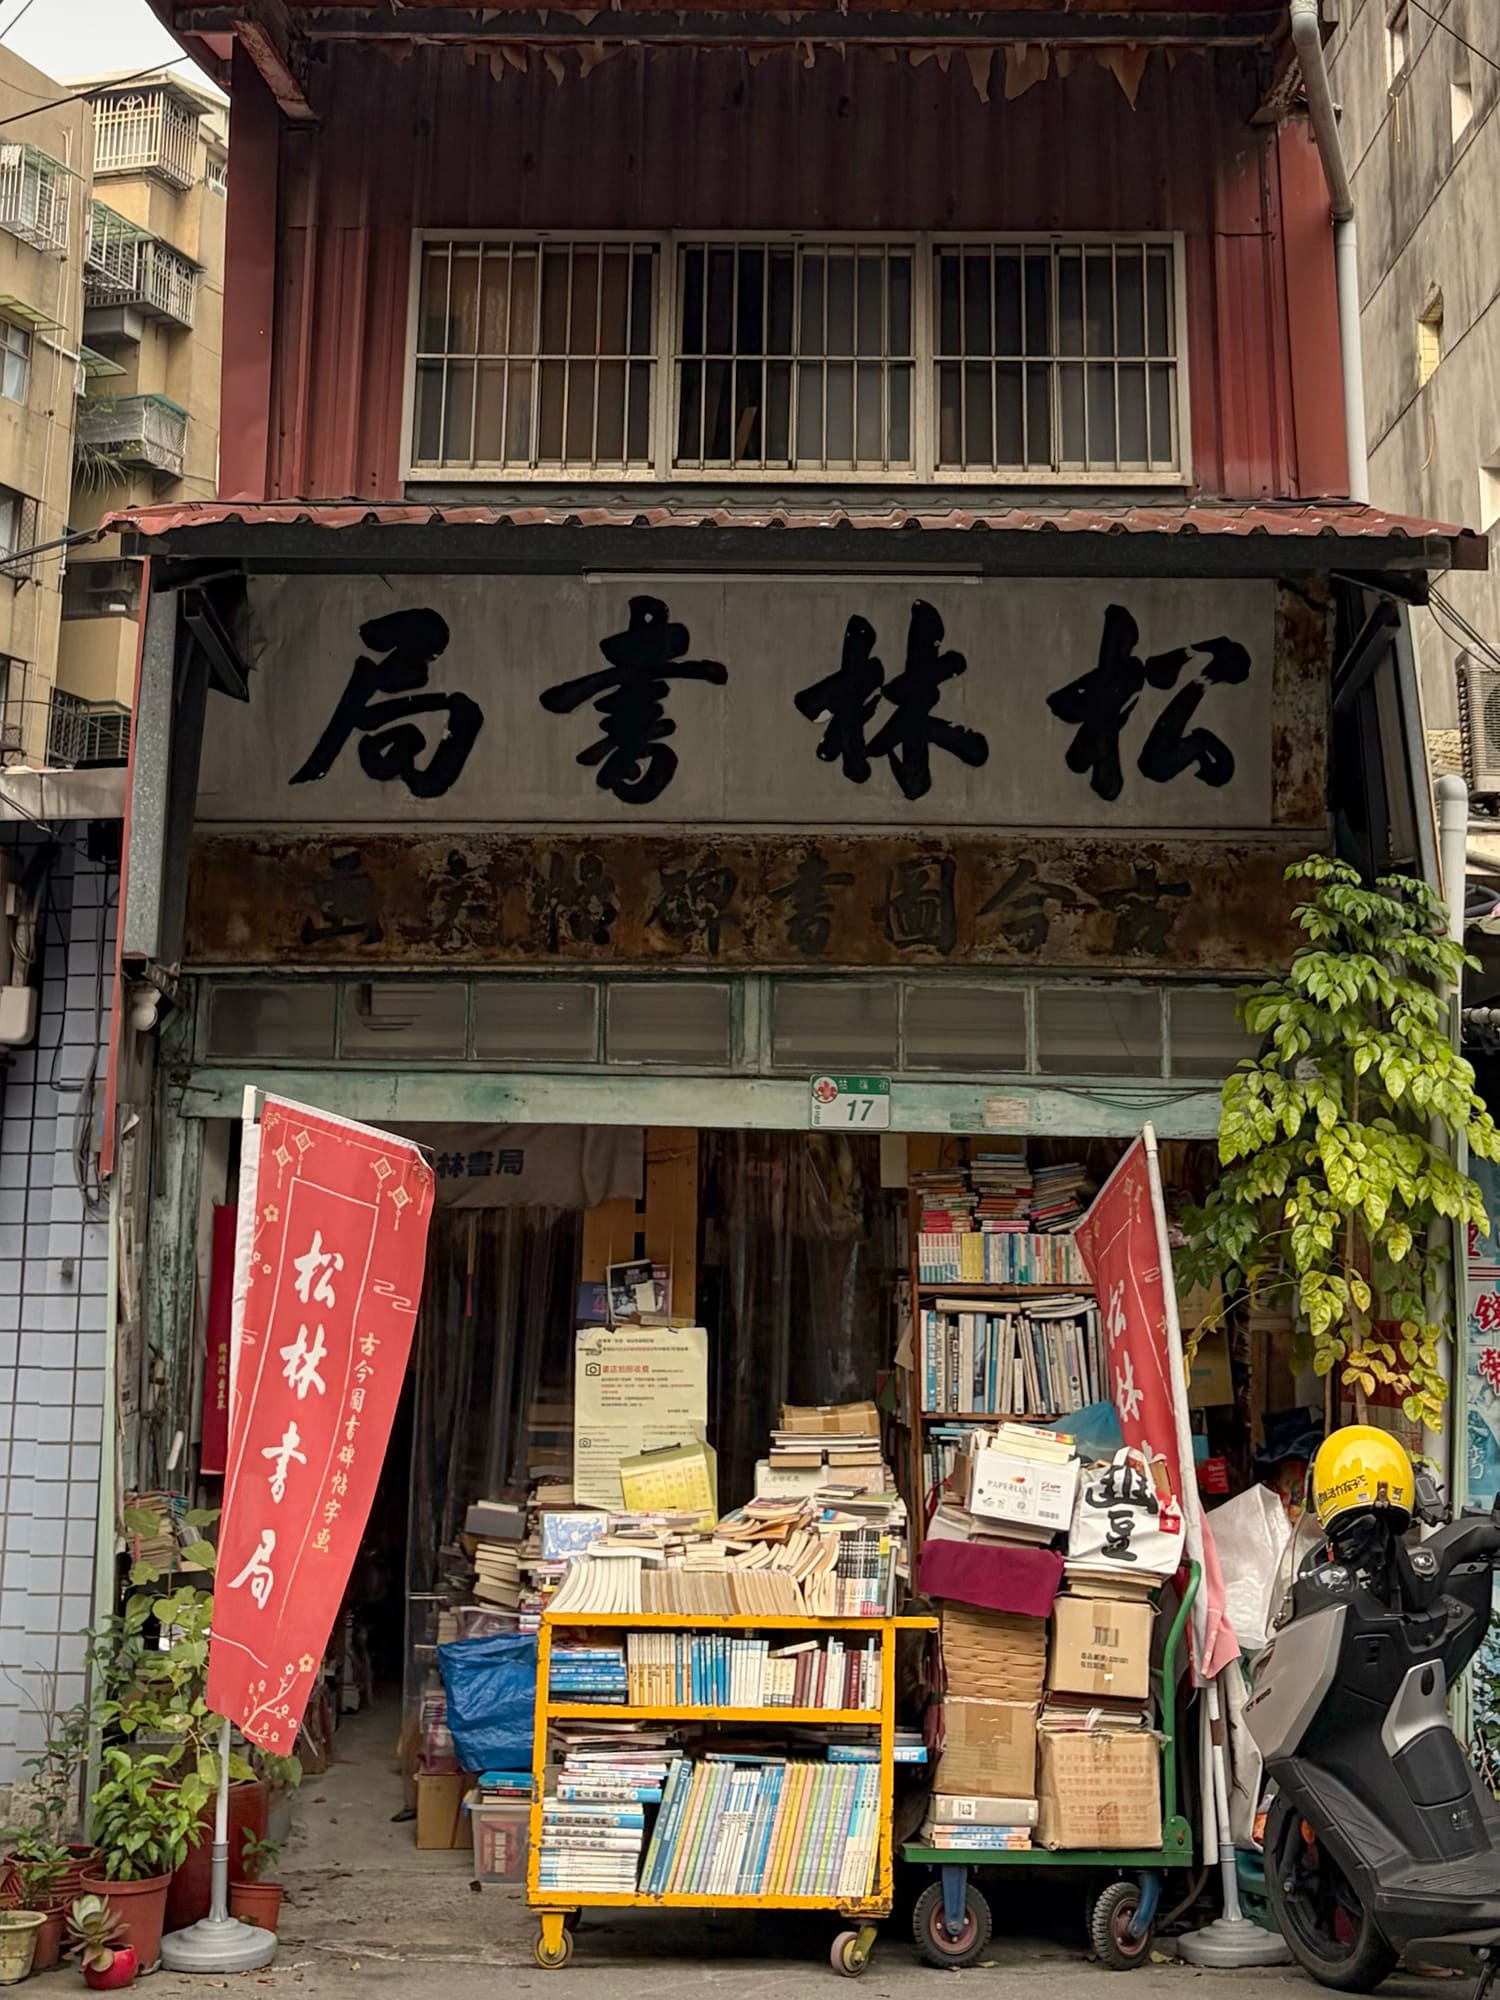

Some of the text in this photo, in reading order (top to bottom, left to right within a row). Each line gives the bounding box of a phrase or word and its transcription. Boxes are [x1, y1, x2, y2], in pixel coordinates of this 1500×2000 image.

[289, 595, 1251, 804] 松林書局
[436, 1149, 524, 1178] 林書局
[847, 1099, 874, 1121] 17
[228, 1230, 344, 1610] 松林書局
